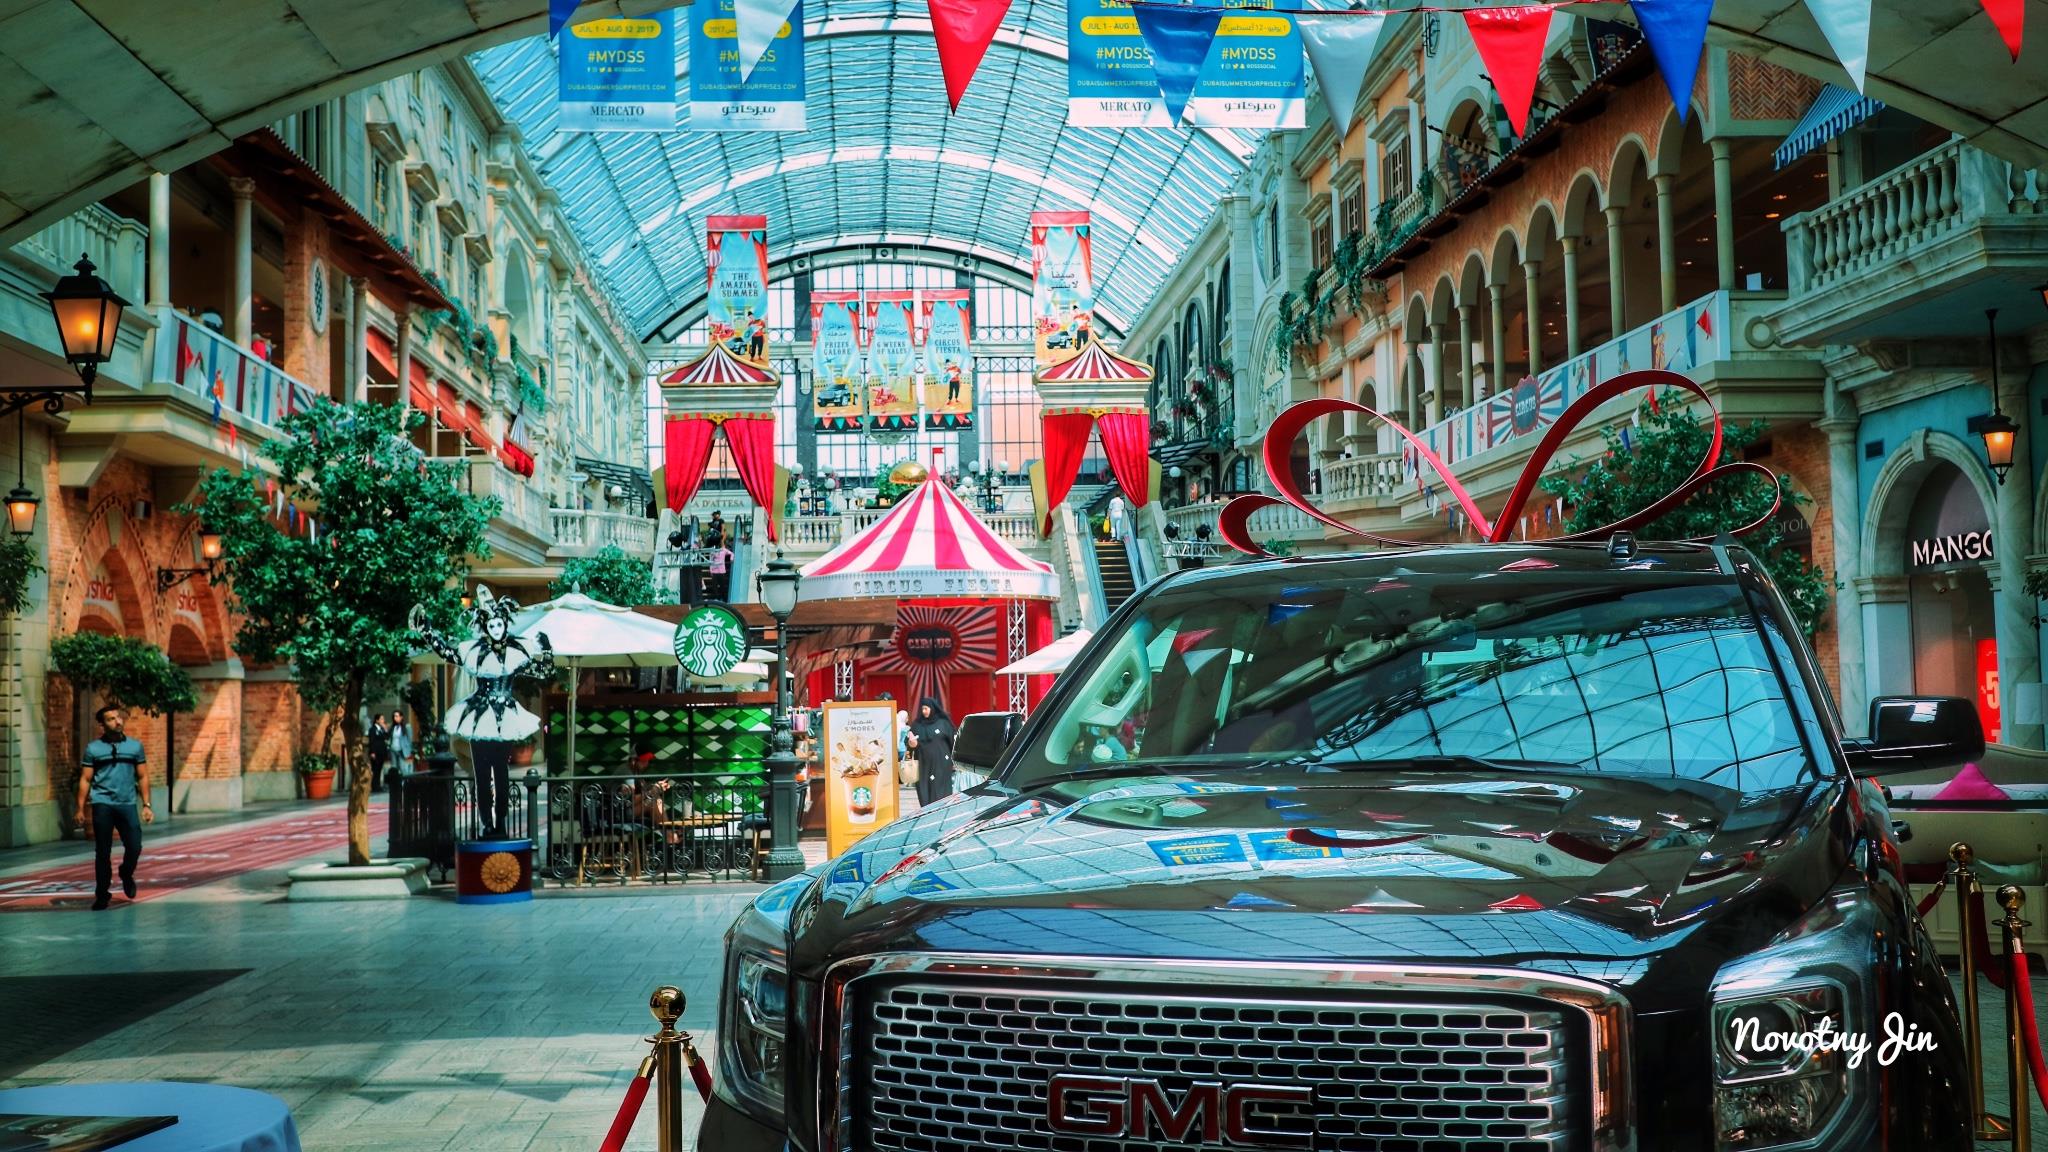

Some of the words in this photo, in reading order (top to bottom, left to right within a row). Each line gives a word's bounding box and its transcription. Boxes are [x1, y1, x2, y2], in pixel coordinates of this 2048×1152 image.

[588, 50, 645, 63] #MYDSS
[720, 49, 776, 62] #MSS
[1096, 47, 1149, 60] #MYDSS
[1222, 47, 1276, 60] #MYDSS
[590, 105, 645, 117] MERCATO
[1100, 101, 1152, 112] MERCATO
[720, 281, 758, 289] AMAZING
[722, 289, 759, 298] SUMMER
[853, 579, 923, 594] CIRCUS
[944, 578, 1014, 592] FIESTA
[907, 637, 952, 649] CIRCUS
[1046, 1073, 1313, 1150] GMC
